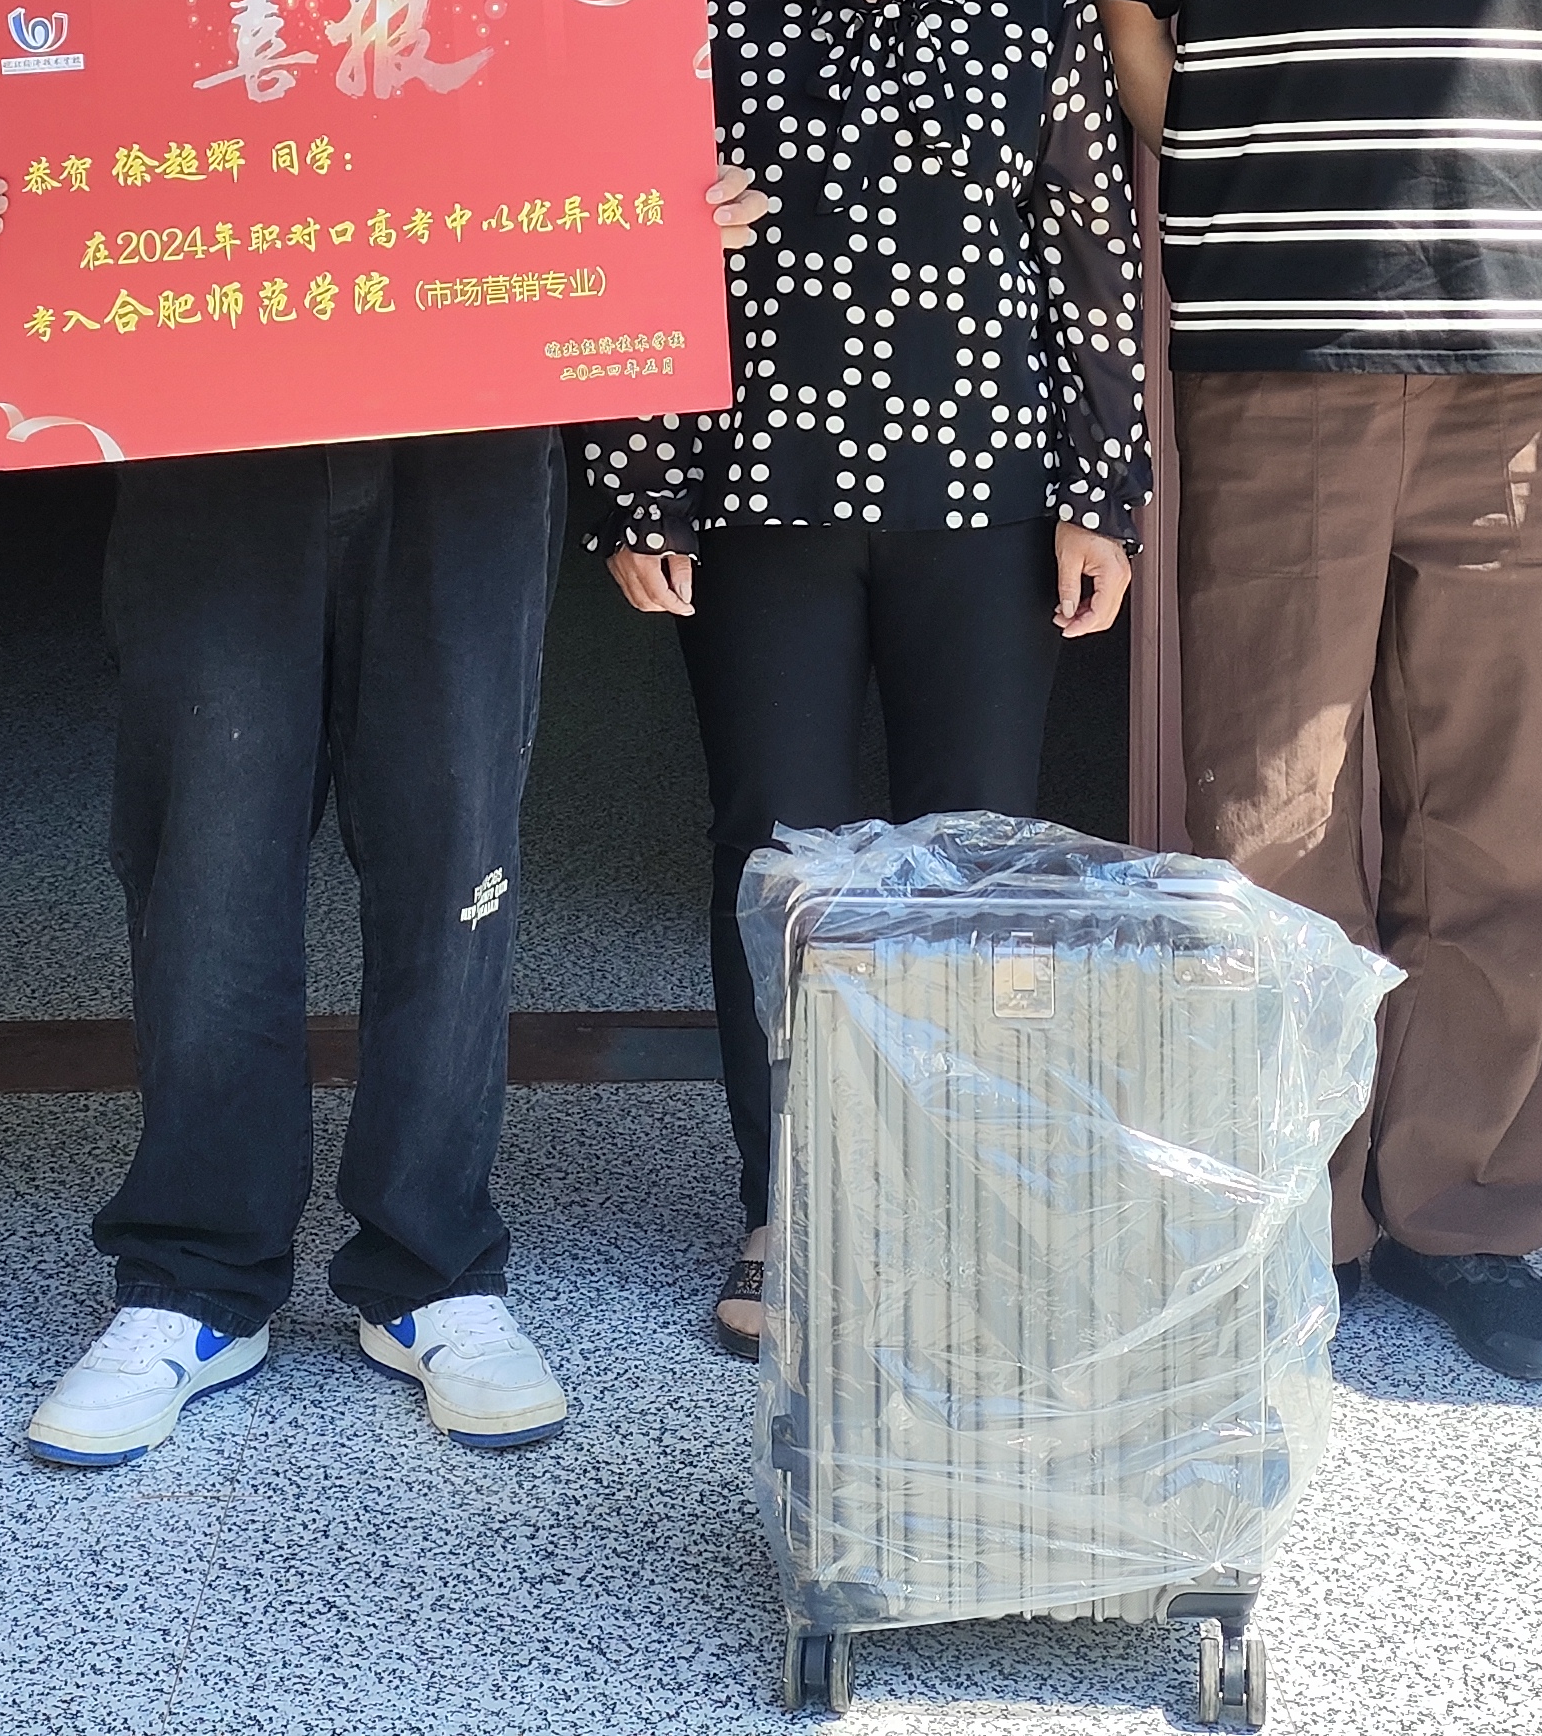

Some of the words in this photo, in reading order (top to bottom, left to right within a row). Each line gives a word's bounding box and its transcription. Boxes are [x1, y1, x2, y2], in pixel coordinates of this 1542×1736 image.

[22, 155, 93, 195] 恭贺
[80, 189, 664, 271] 在2024年职对口高考中以优异成绩
[24, 271, 395, 342] 考入合肥师范学院
